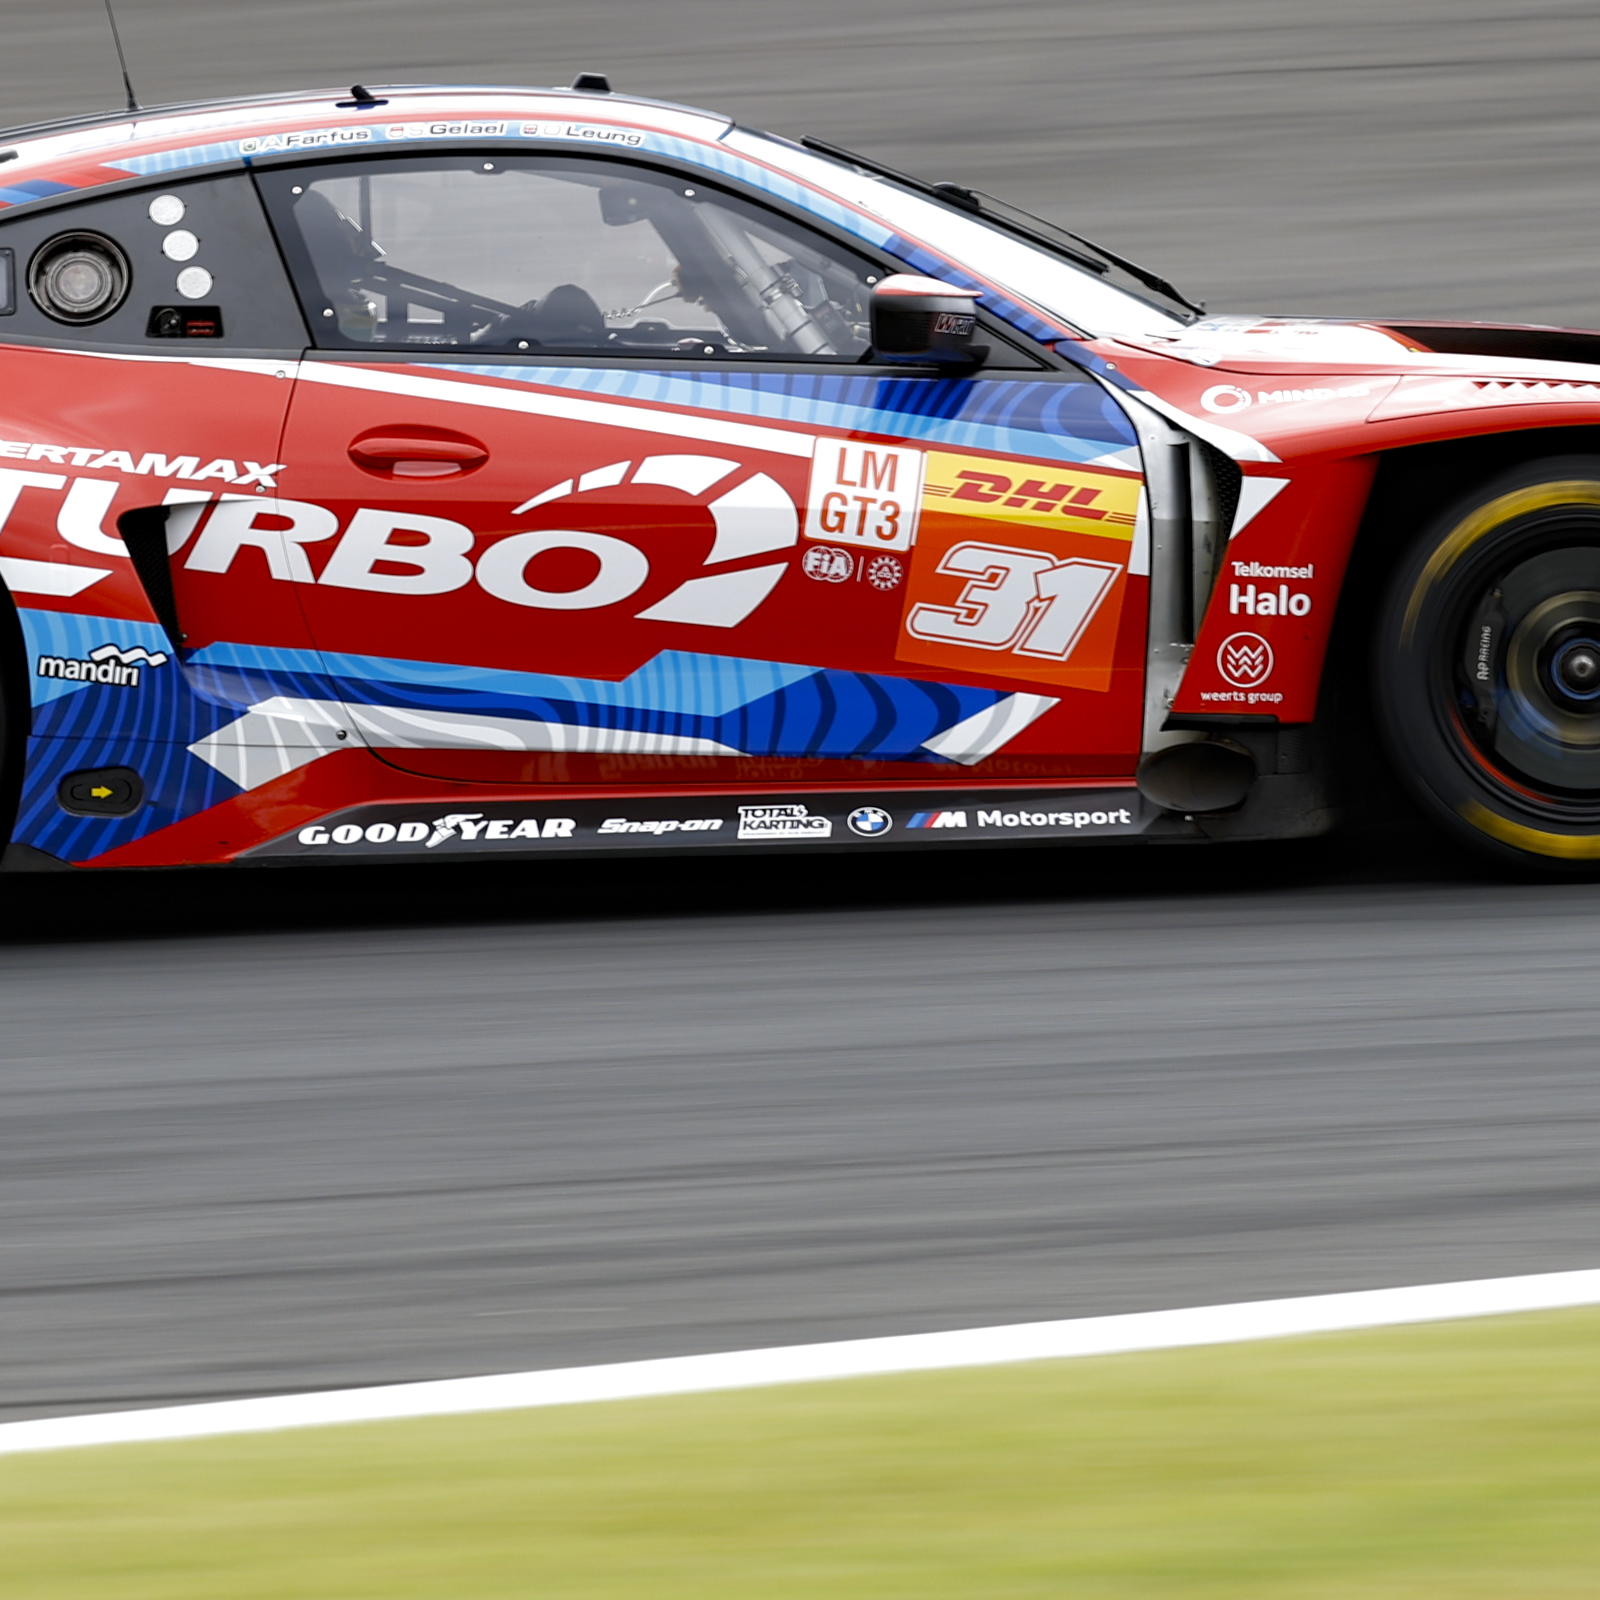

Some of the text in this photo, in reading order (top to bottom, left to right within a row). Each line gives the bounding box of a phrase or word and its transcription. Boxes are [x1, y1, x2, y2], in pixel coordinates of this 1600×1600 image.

[287, 131, 368, 146] Farfus
[429, 123, 505, 135] Gelael
[566, 126, 642, 146] Leung
[835, 446, 898, 493] LM
[952, 470, 1111, 521] DHL
[819, 492, 901, 542] GT3
[1230, 560, 1314, 580] Telkomsel
[905, 540, 1124, 662] 31
[1228, 583, 1312, 617] Halo
[38, 656, 139, 686] mandiri
[1201, 691, 1283, 705] weerts group
[597, 817, 724, 835] Snap-on
[742, 818, 826, 831] KARTING
[977, 808, 1131, 829] Motorsport
[297, 816, 578, 846] GOODYEAR
